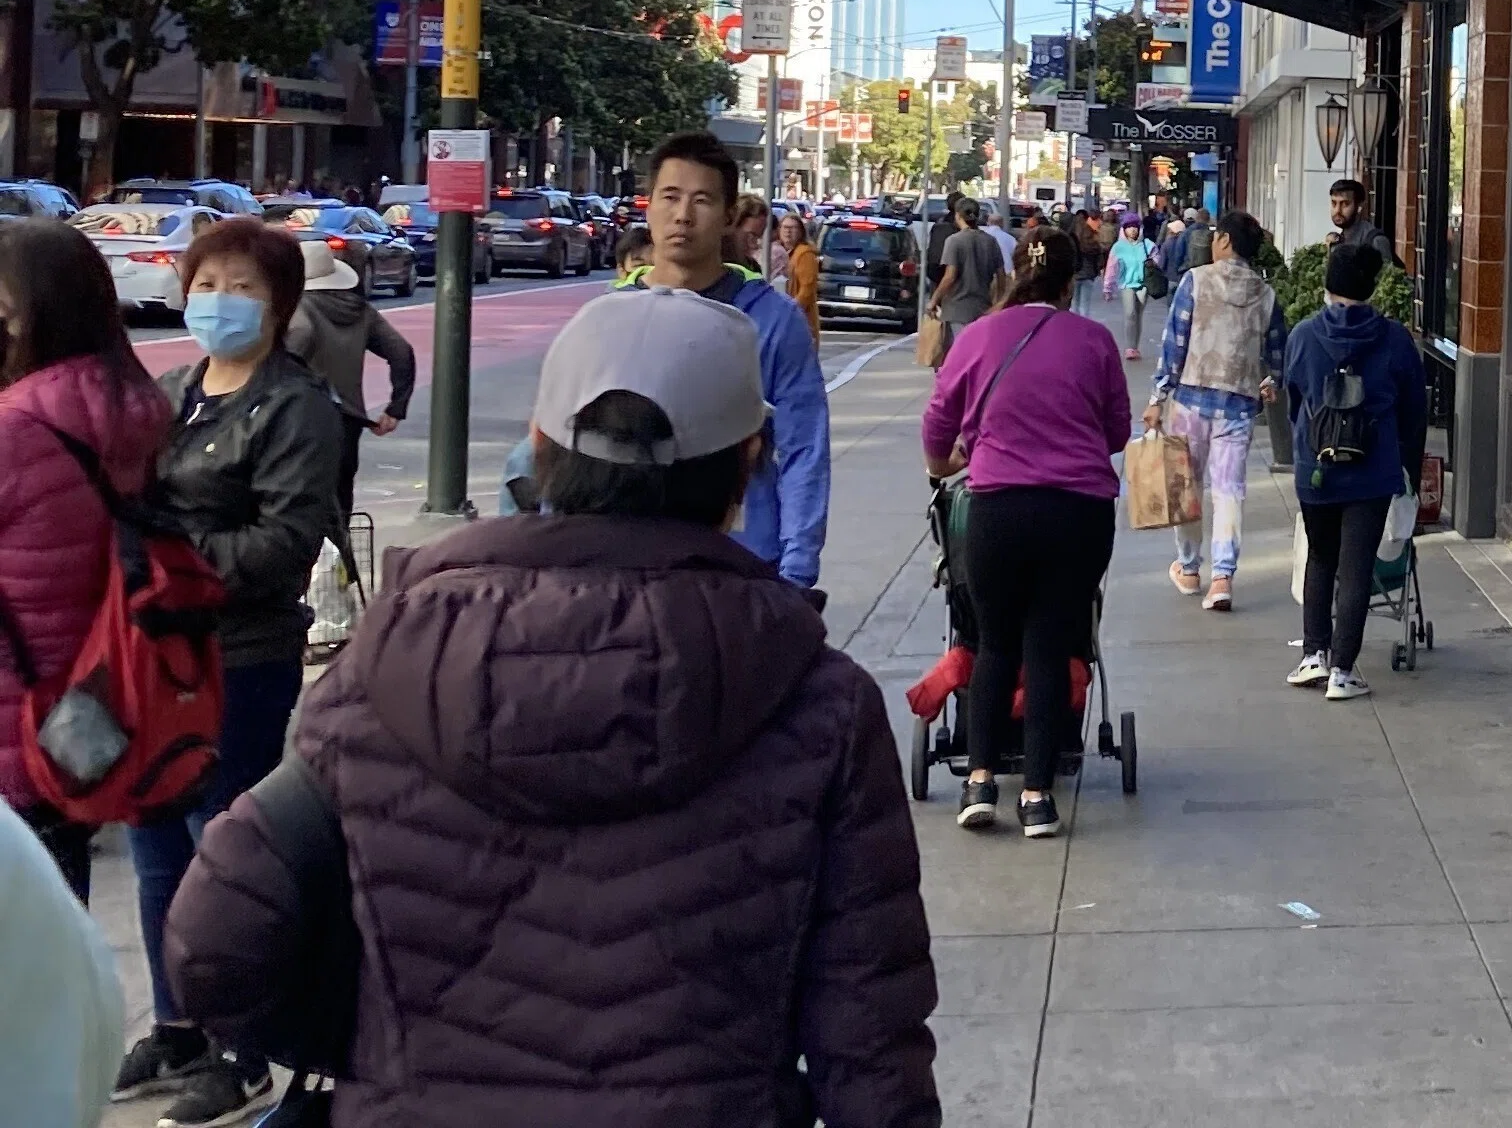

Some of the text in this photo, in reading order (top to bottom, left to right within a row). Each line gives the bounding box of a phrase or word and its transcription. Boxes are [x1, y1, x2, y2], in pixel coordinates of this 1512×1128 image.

[1206, 21, 1230, 72] The
[1112, 113, 1217, 140] The MOSSER
